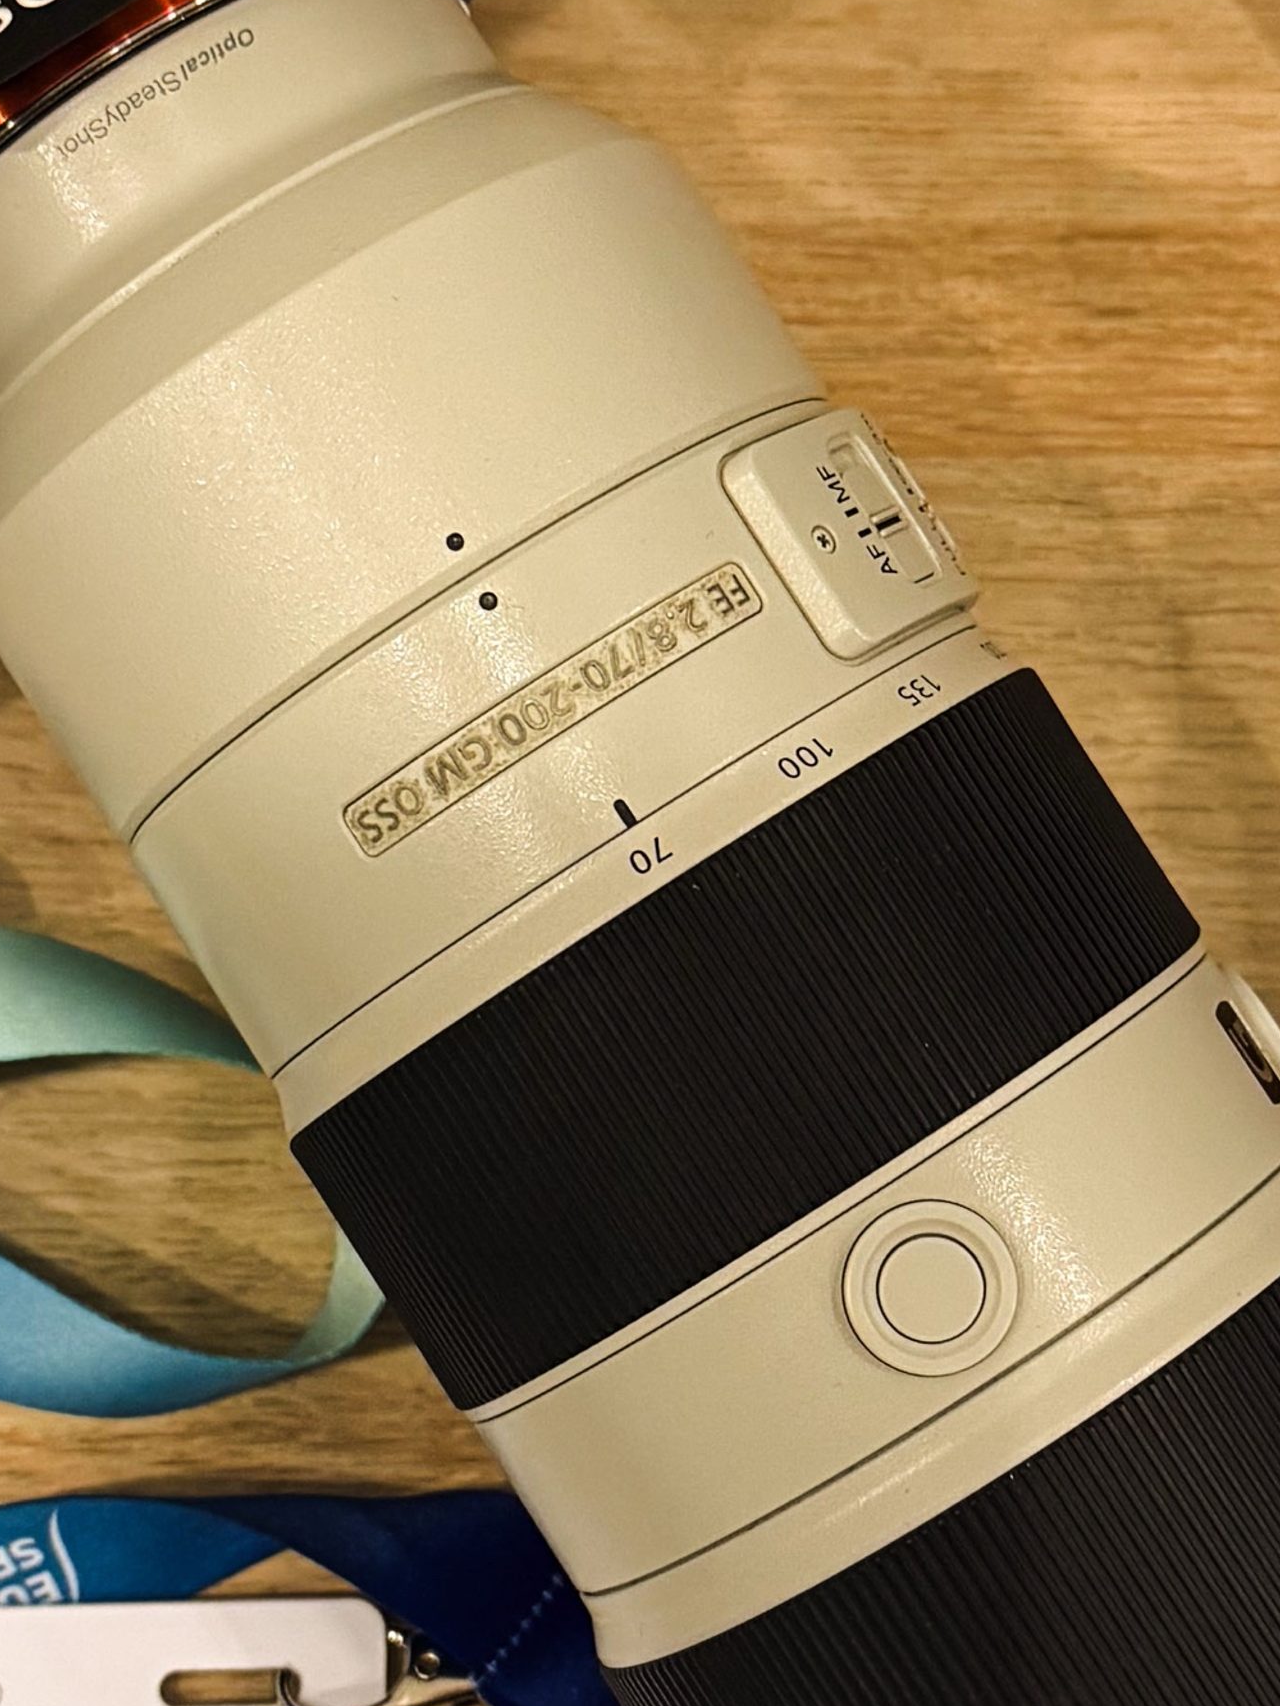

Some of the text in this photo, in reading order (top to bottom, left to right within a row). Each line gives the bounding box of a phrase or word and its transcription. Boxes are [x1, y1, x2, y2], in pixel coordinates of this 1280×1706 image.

[56, 27, 256, 160] Optical SteadyShot
[815, 465, 851, 504] MF
[866, 544, 899, 575] AF
[706, 573, 751, 618] FE
[897, 673, 942, 707] 135
[423, 736, 494, 798] GM
[776, 737, 835, 782] 100
[355, 784, 422, 846] OSS
[628, 835, 674, 876] 70
